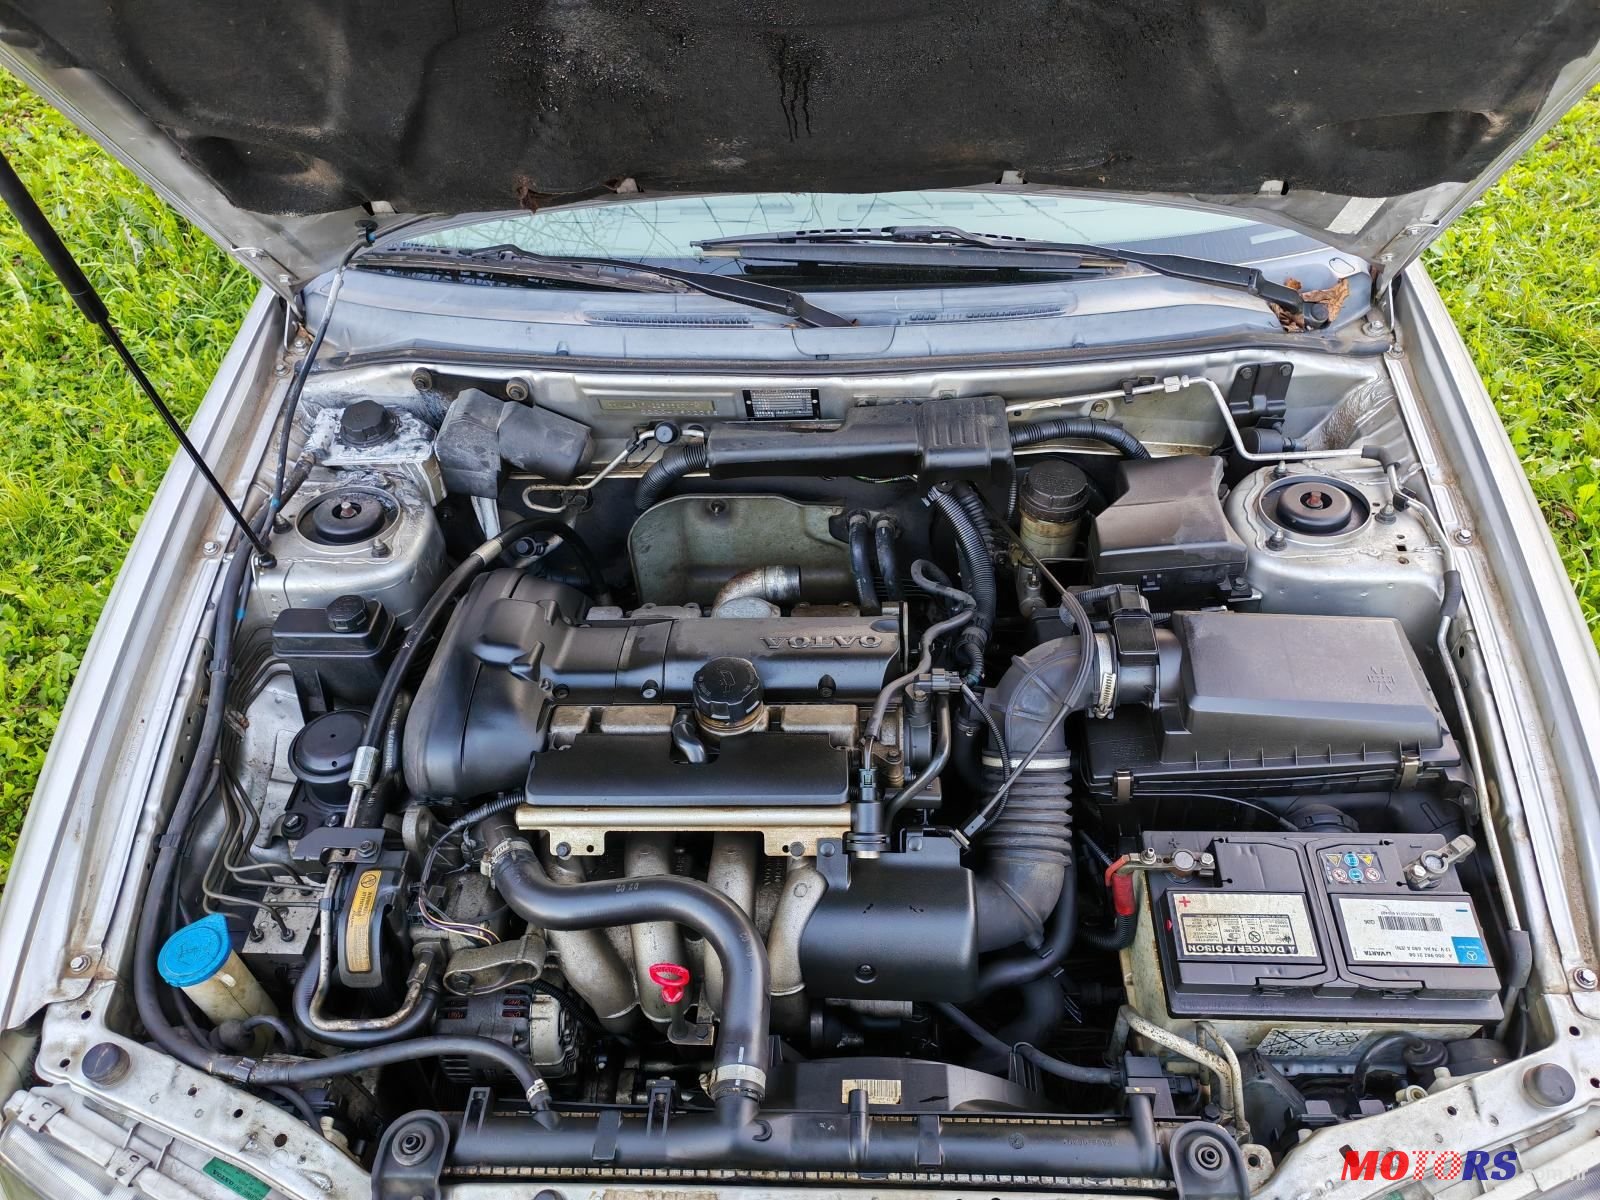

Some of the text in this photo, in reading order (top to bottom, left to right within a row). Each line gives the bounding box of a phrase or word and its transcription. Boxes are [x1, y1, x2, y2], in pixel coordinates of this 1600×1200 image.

[760, 635, 882, 649] VOLVO
[1188, 944, 1285, 953] DANGER/POISON
[212, 1169, 234, 1186] VOLVO
